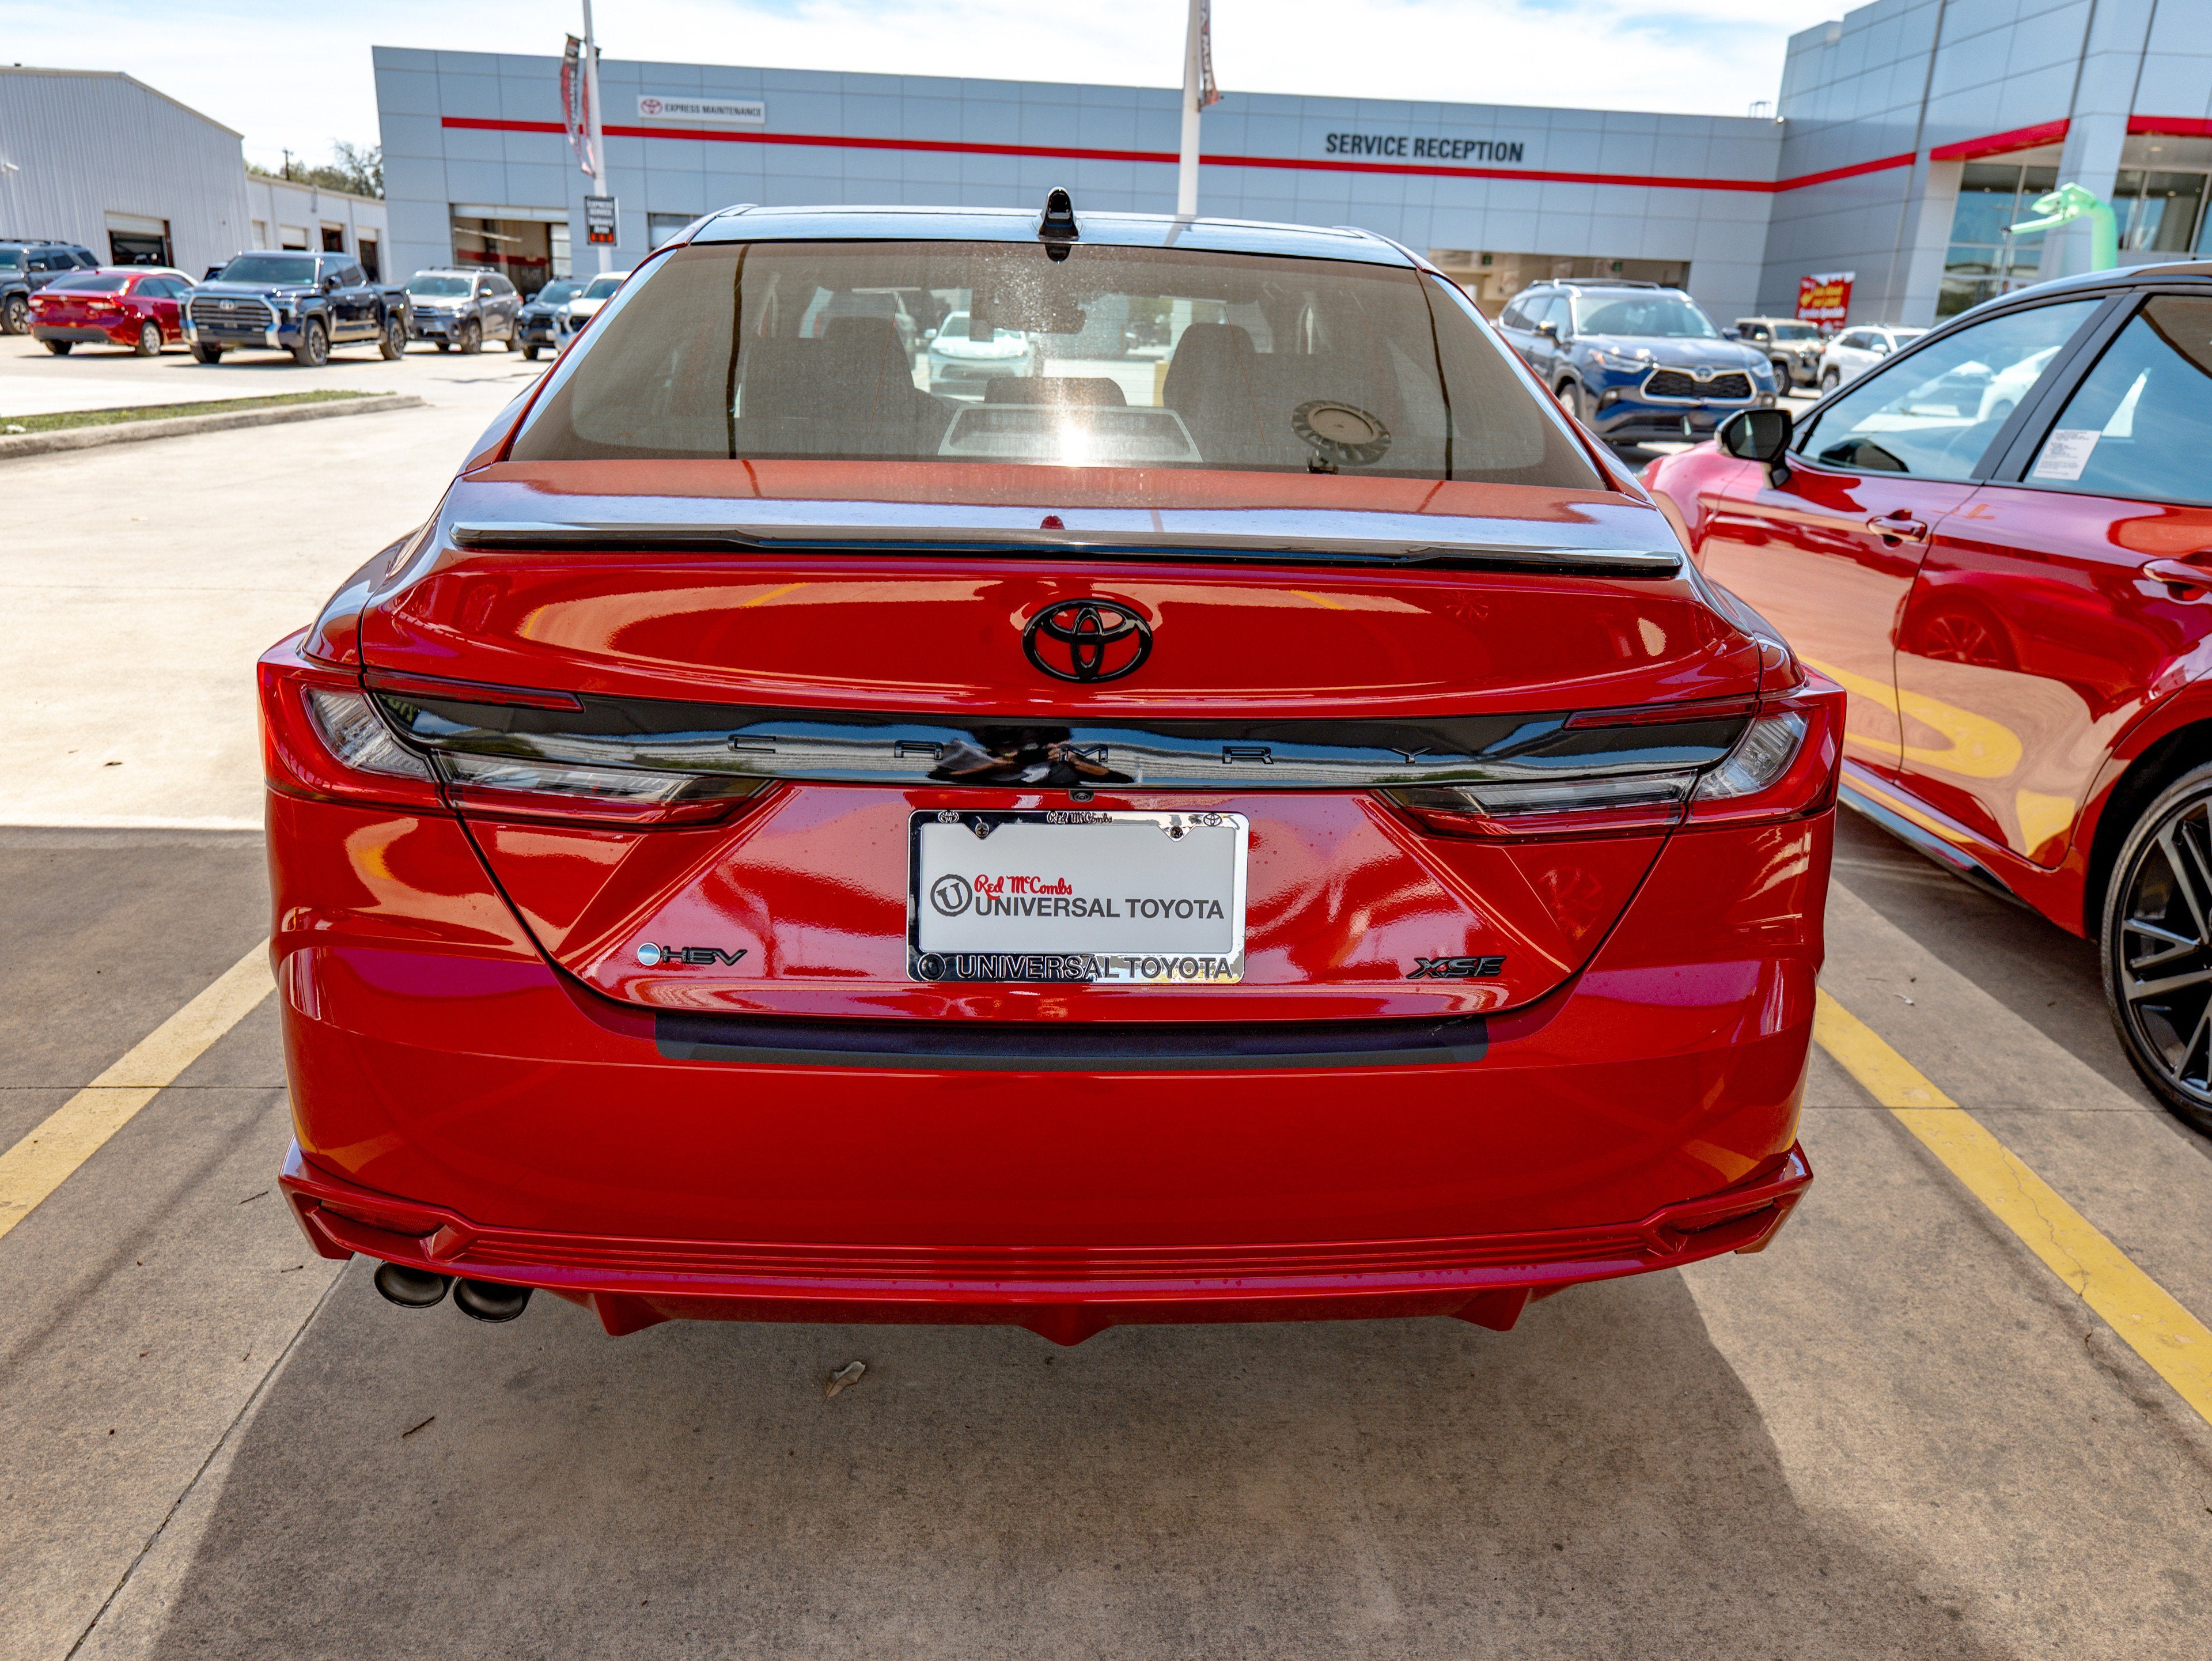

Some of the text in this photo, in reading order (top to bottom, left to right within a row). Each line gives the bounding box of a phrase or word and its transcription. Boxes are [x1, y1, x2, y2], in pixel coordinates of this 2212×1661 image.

[664, 103, 761, 117] EXPRESS MAINTENANCE
[1325, 134, 1524, 162] SERVICE RECEPTION
[728, 734, 1438, 765] CAMRY
[974, 874, 1073, 901] Red McCombs
[975, 896, 1224, 920] UNIVERSAL TOYOTA
[662, 945, 748, 966] HEV
[956, 955, 1233, 979] UNIVERSAL TOYOTA
[1406, 955, 1506, 979] XSE
